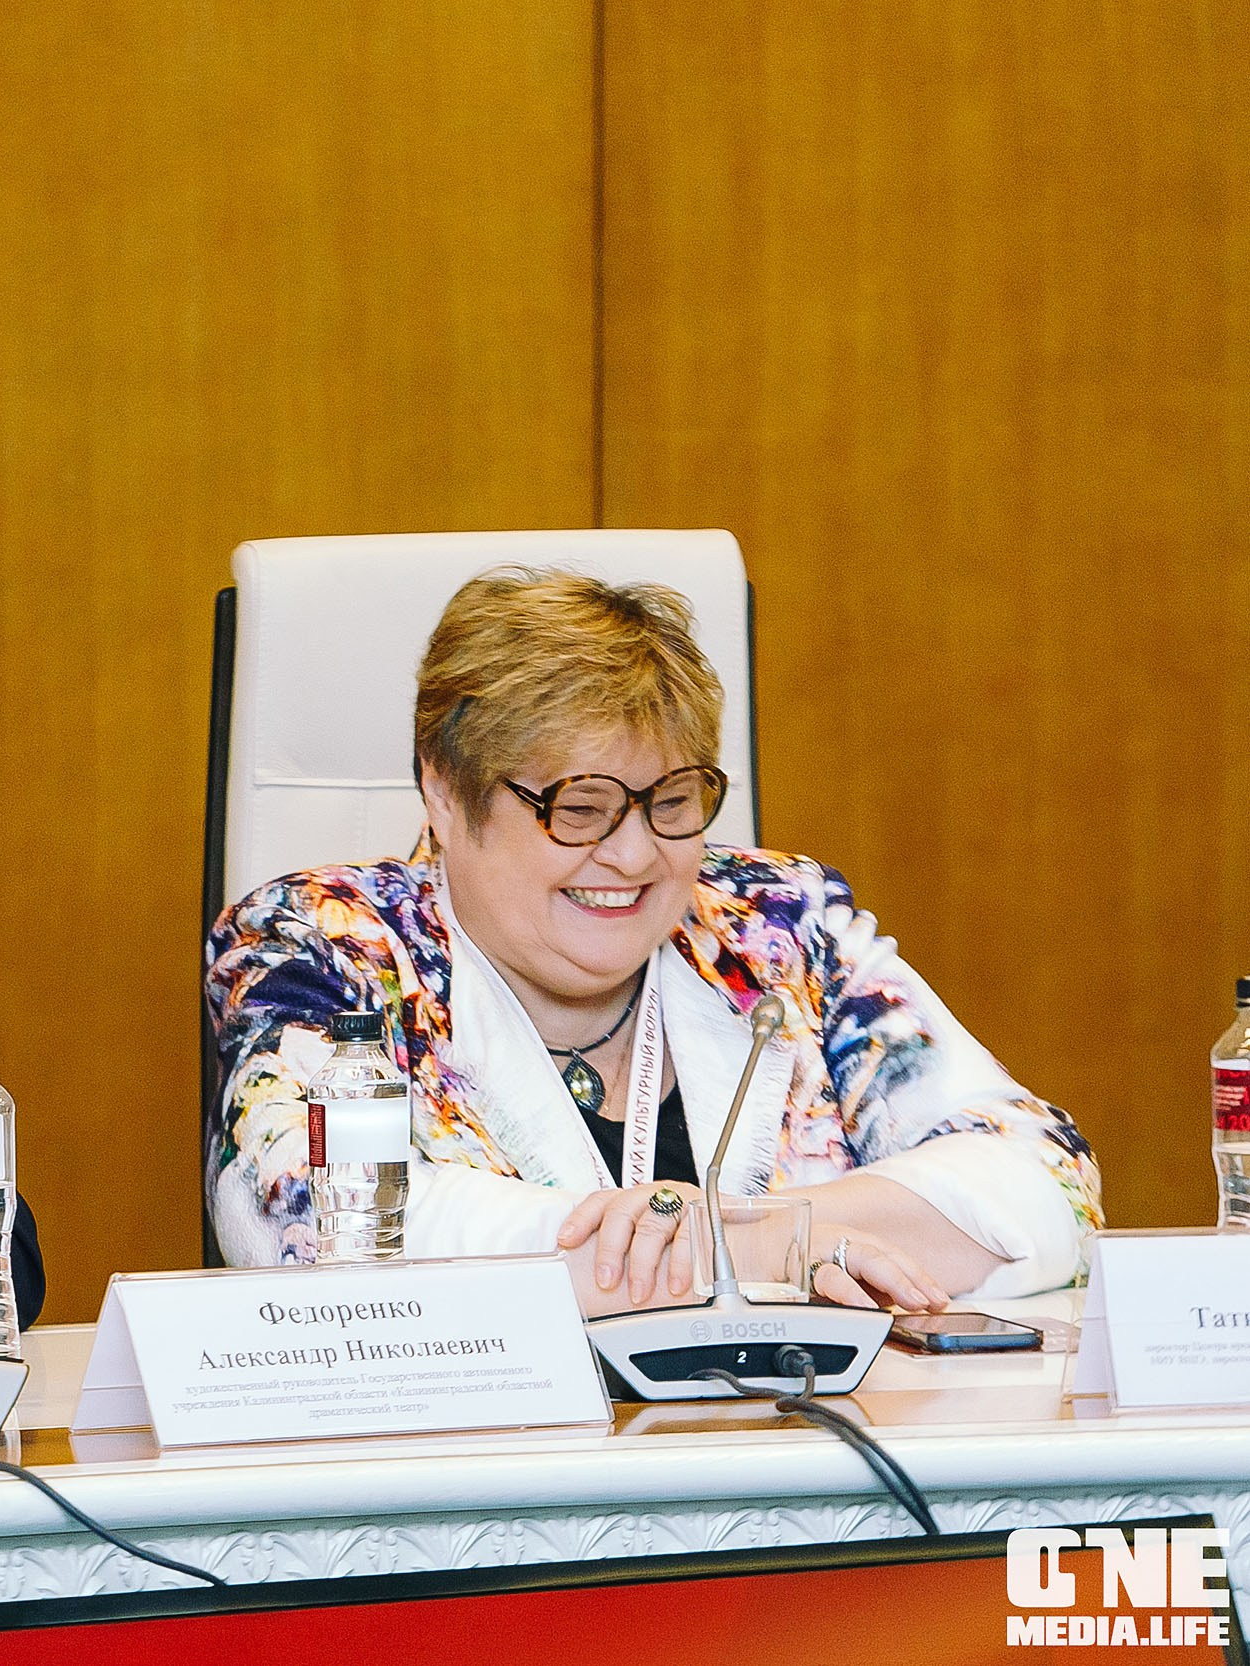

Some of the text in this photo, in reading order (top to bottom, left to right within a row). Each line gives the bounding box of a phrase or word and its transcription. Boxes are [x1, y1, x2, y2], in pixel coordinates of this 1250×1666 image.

[644, 986, 659, 1042] ФОРУМ
[632, 1043, 657, 1145] КУЛЬТУРНЫЙ
[259, 1300, 422, 1328] Федоренко
[721, 1322, 787, 1339] BOSCH
[199, 1336, 507, 1371] Александр Николаевич
[736, 1351, 748, 1364] 2
